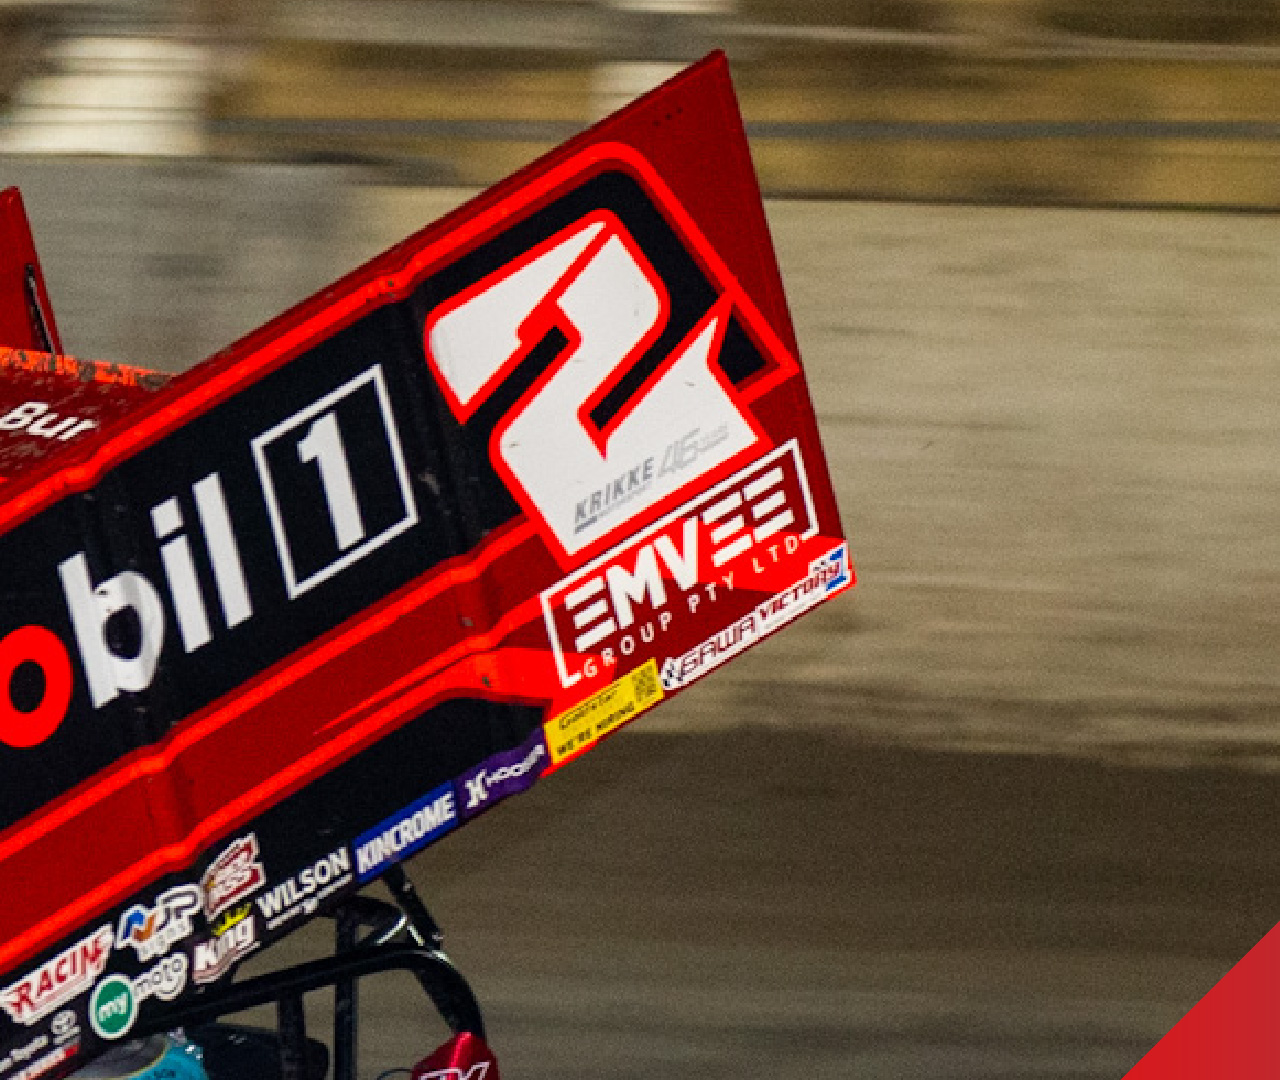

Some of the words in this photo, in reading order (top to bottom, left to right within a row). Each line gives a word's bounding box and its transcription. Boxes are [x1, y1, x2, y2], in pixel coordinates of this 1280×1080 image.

[425, 215, 758, 556] 2
[298, 412, 366, 555] 1
[574, 456, 655, 524] KRIKKE
[564, 466, 795, 653] EMVEE
[583, 611, 672, 679] GROUP
[687, 572, 734, 614] PTY
[751, 534, 800, 574] LTD
[255, 846, 352, 919] WILSON
[356, 790, 457, 875] KINCROME
